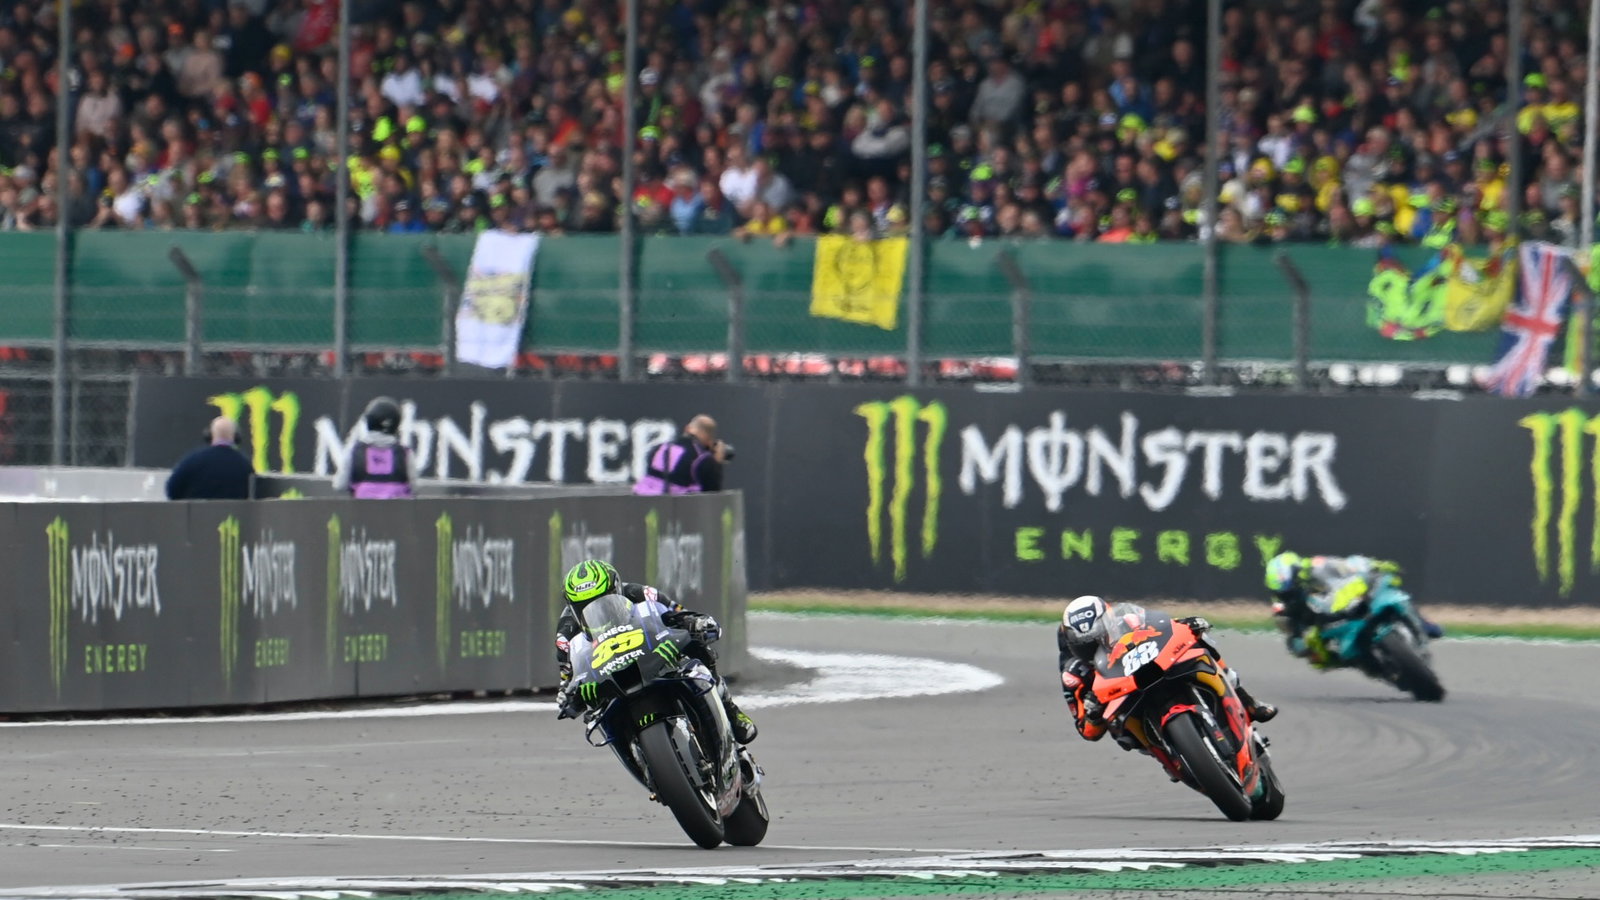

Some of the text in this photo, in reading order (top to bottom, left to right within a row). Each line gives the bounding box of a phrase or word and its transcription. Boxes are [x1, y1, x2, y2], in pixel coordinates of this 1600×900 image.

[959, 410, 1347, 513] MONSTER
[1014, 526, 1284, 570] ENERGY
[71, 530, 161, 626] MONSTER
[597, 624, 634, 642] ENEOS
[85, 643, 147, 674] ENERGY
[599, 649, 646, 676] MONSTER
